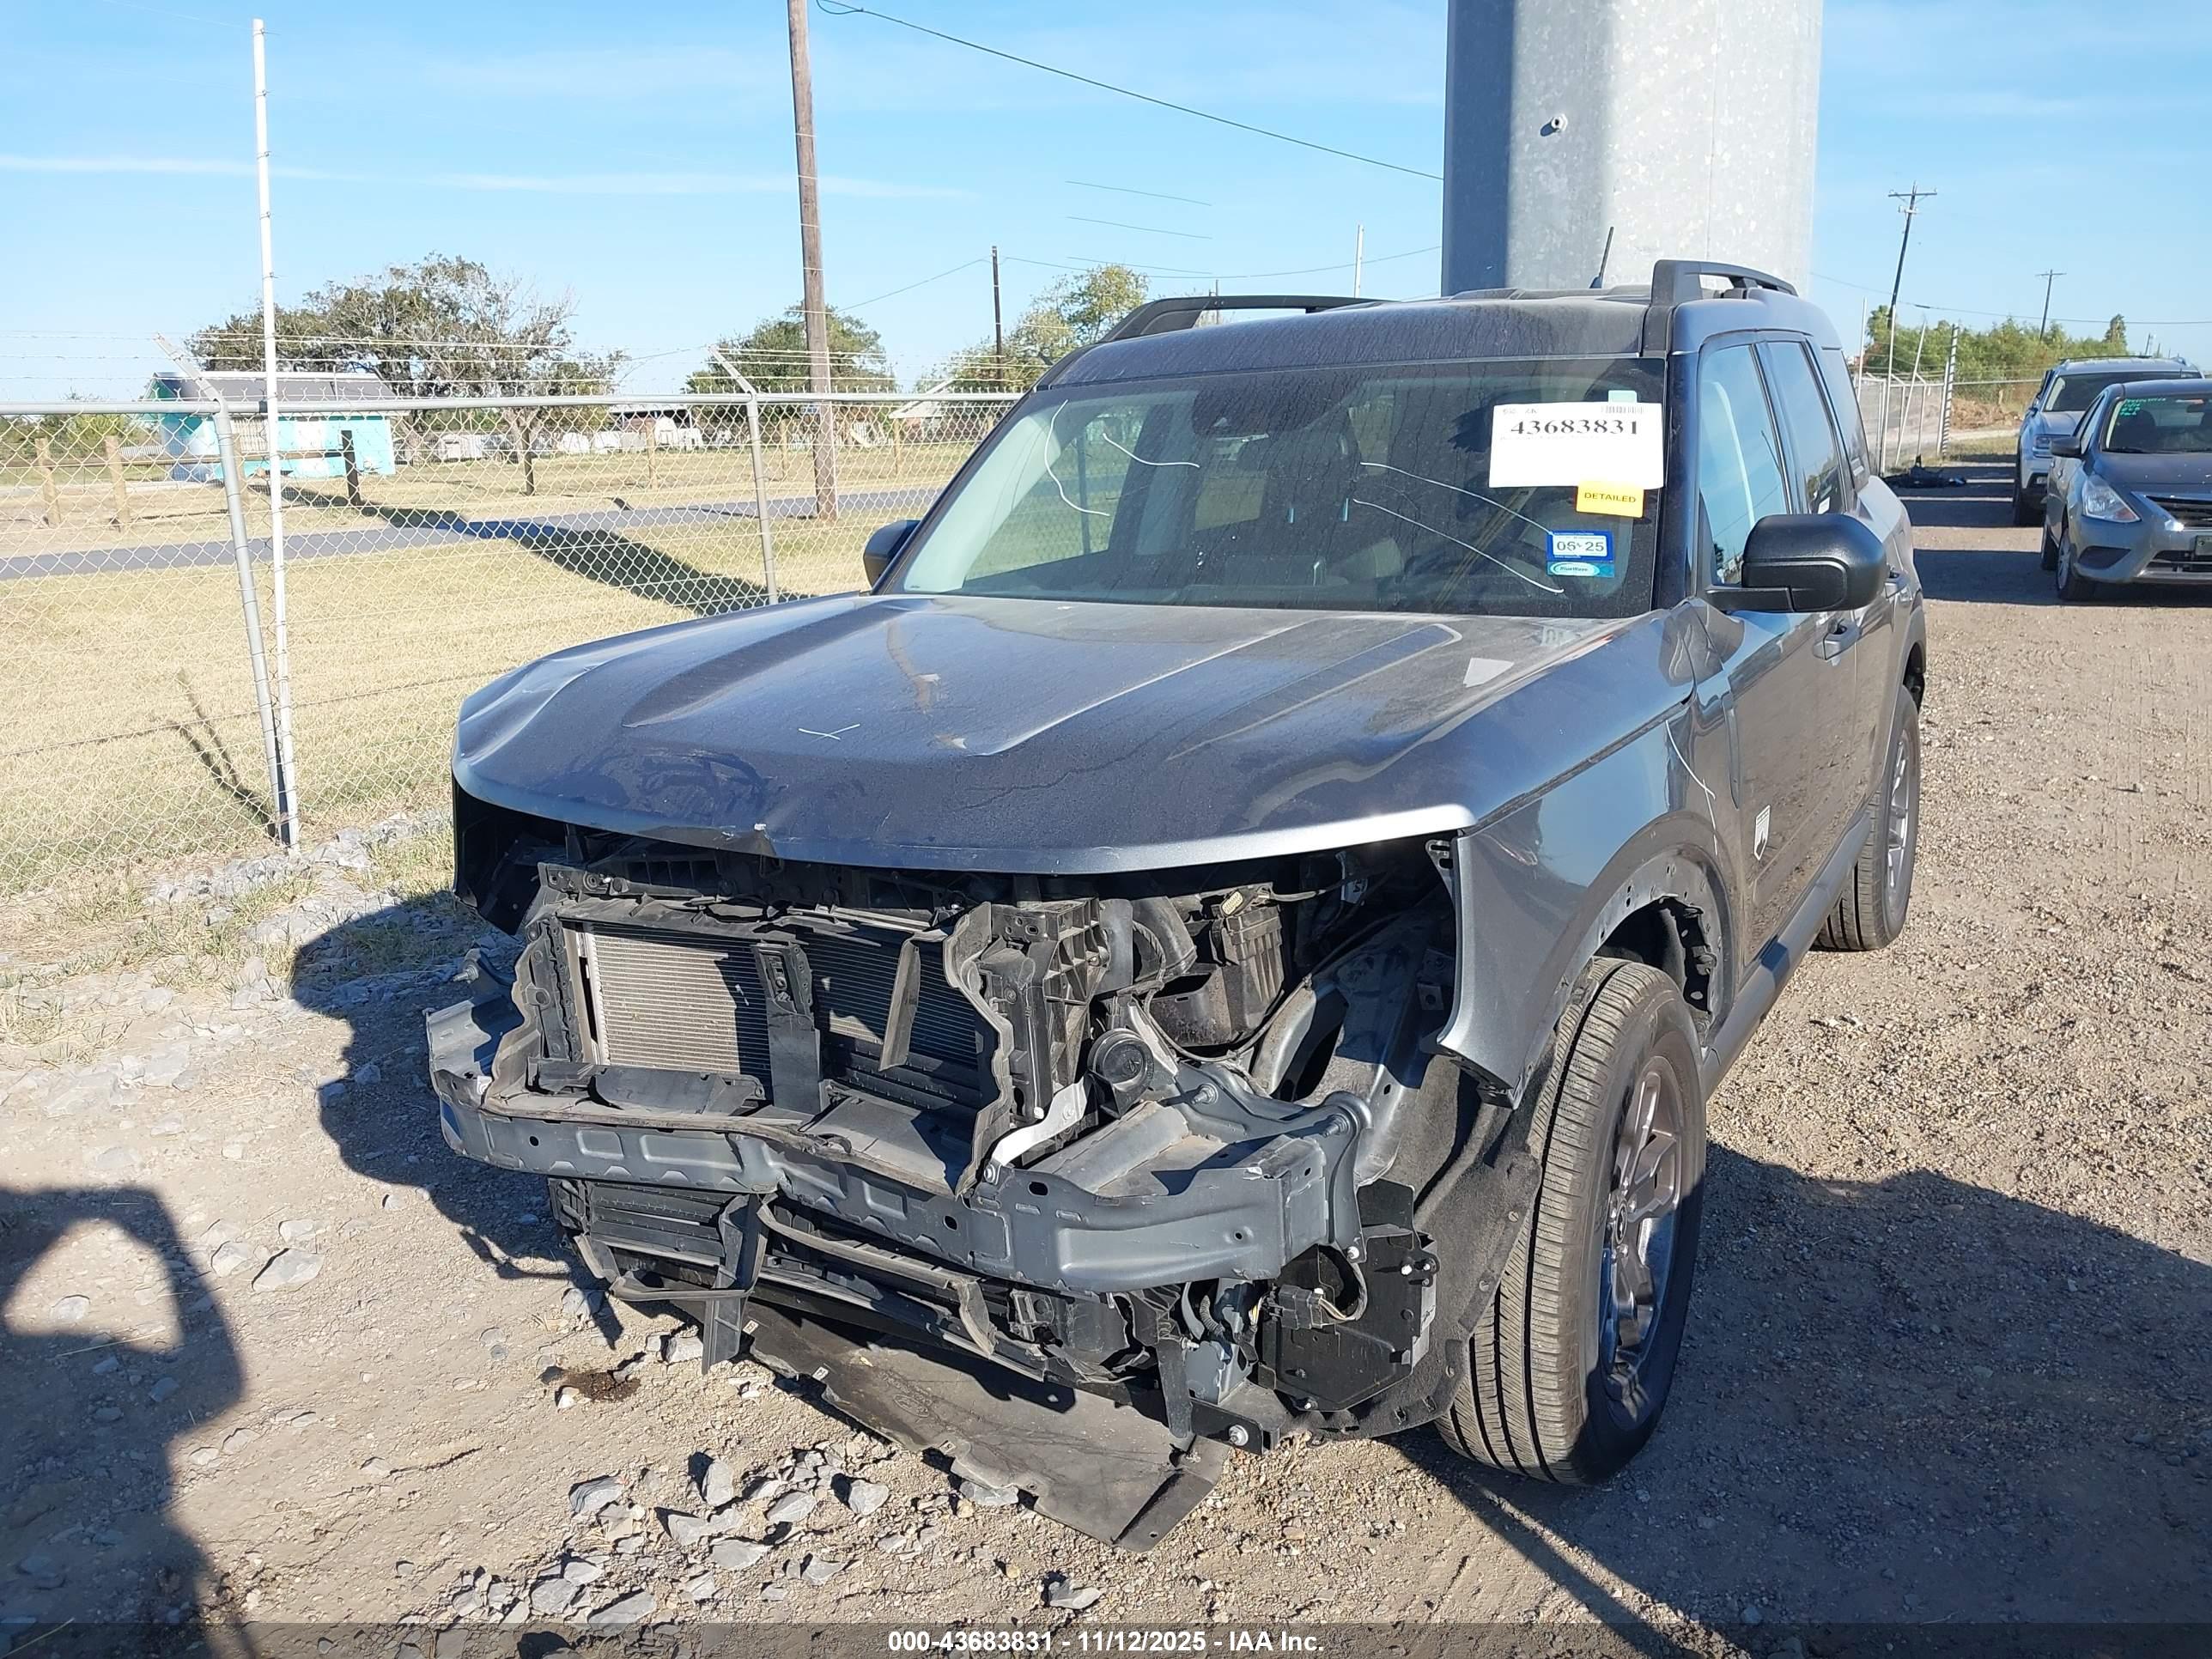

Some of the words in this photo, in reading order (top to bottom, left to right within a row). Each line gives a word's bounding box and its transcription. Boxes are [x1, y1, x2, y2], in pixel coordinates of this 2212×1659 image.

[1511, 419, 1638, 434] 43683831
[1584, 492, 1637, 503] DETAILED
[1585, 542, 1605, 551] 25
